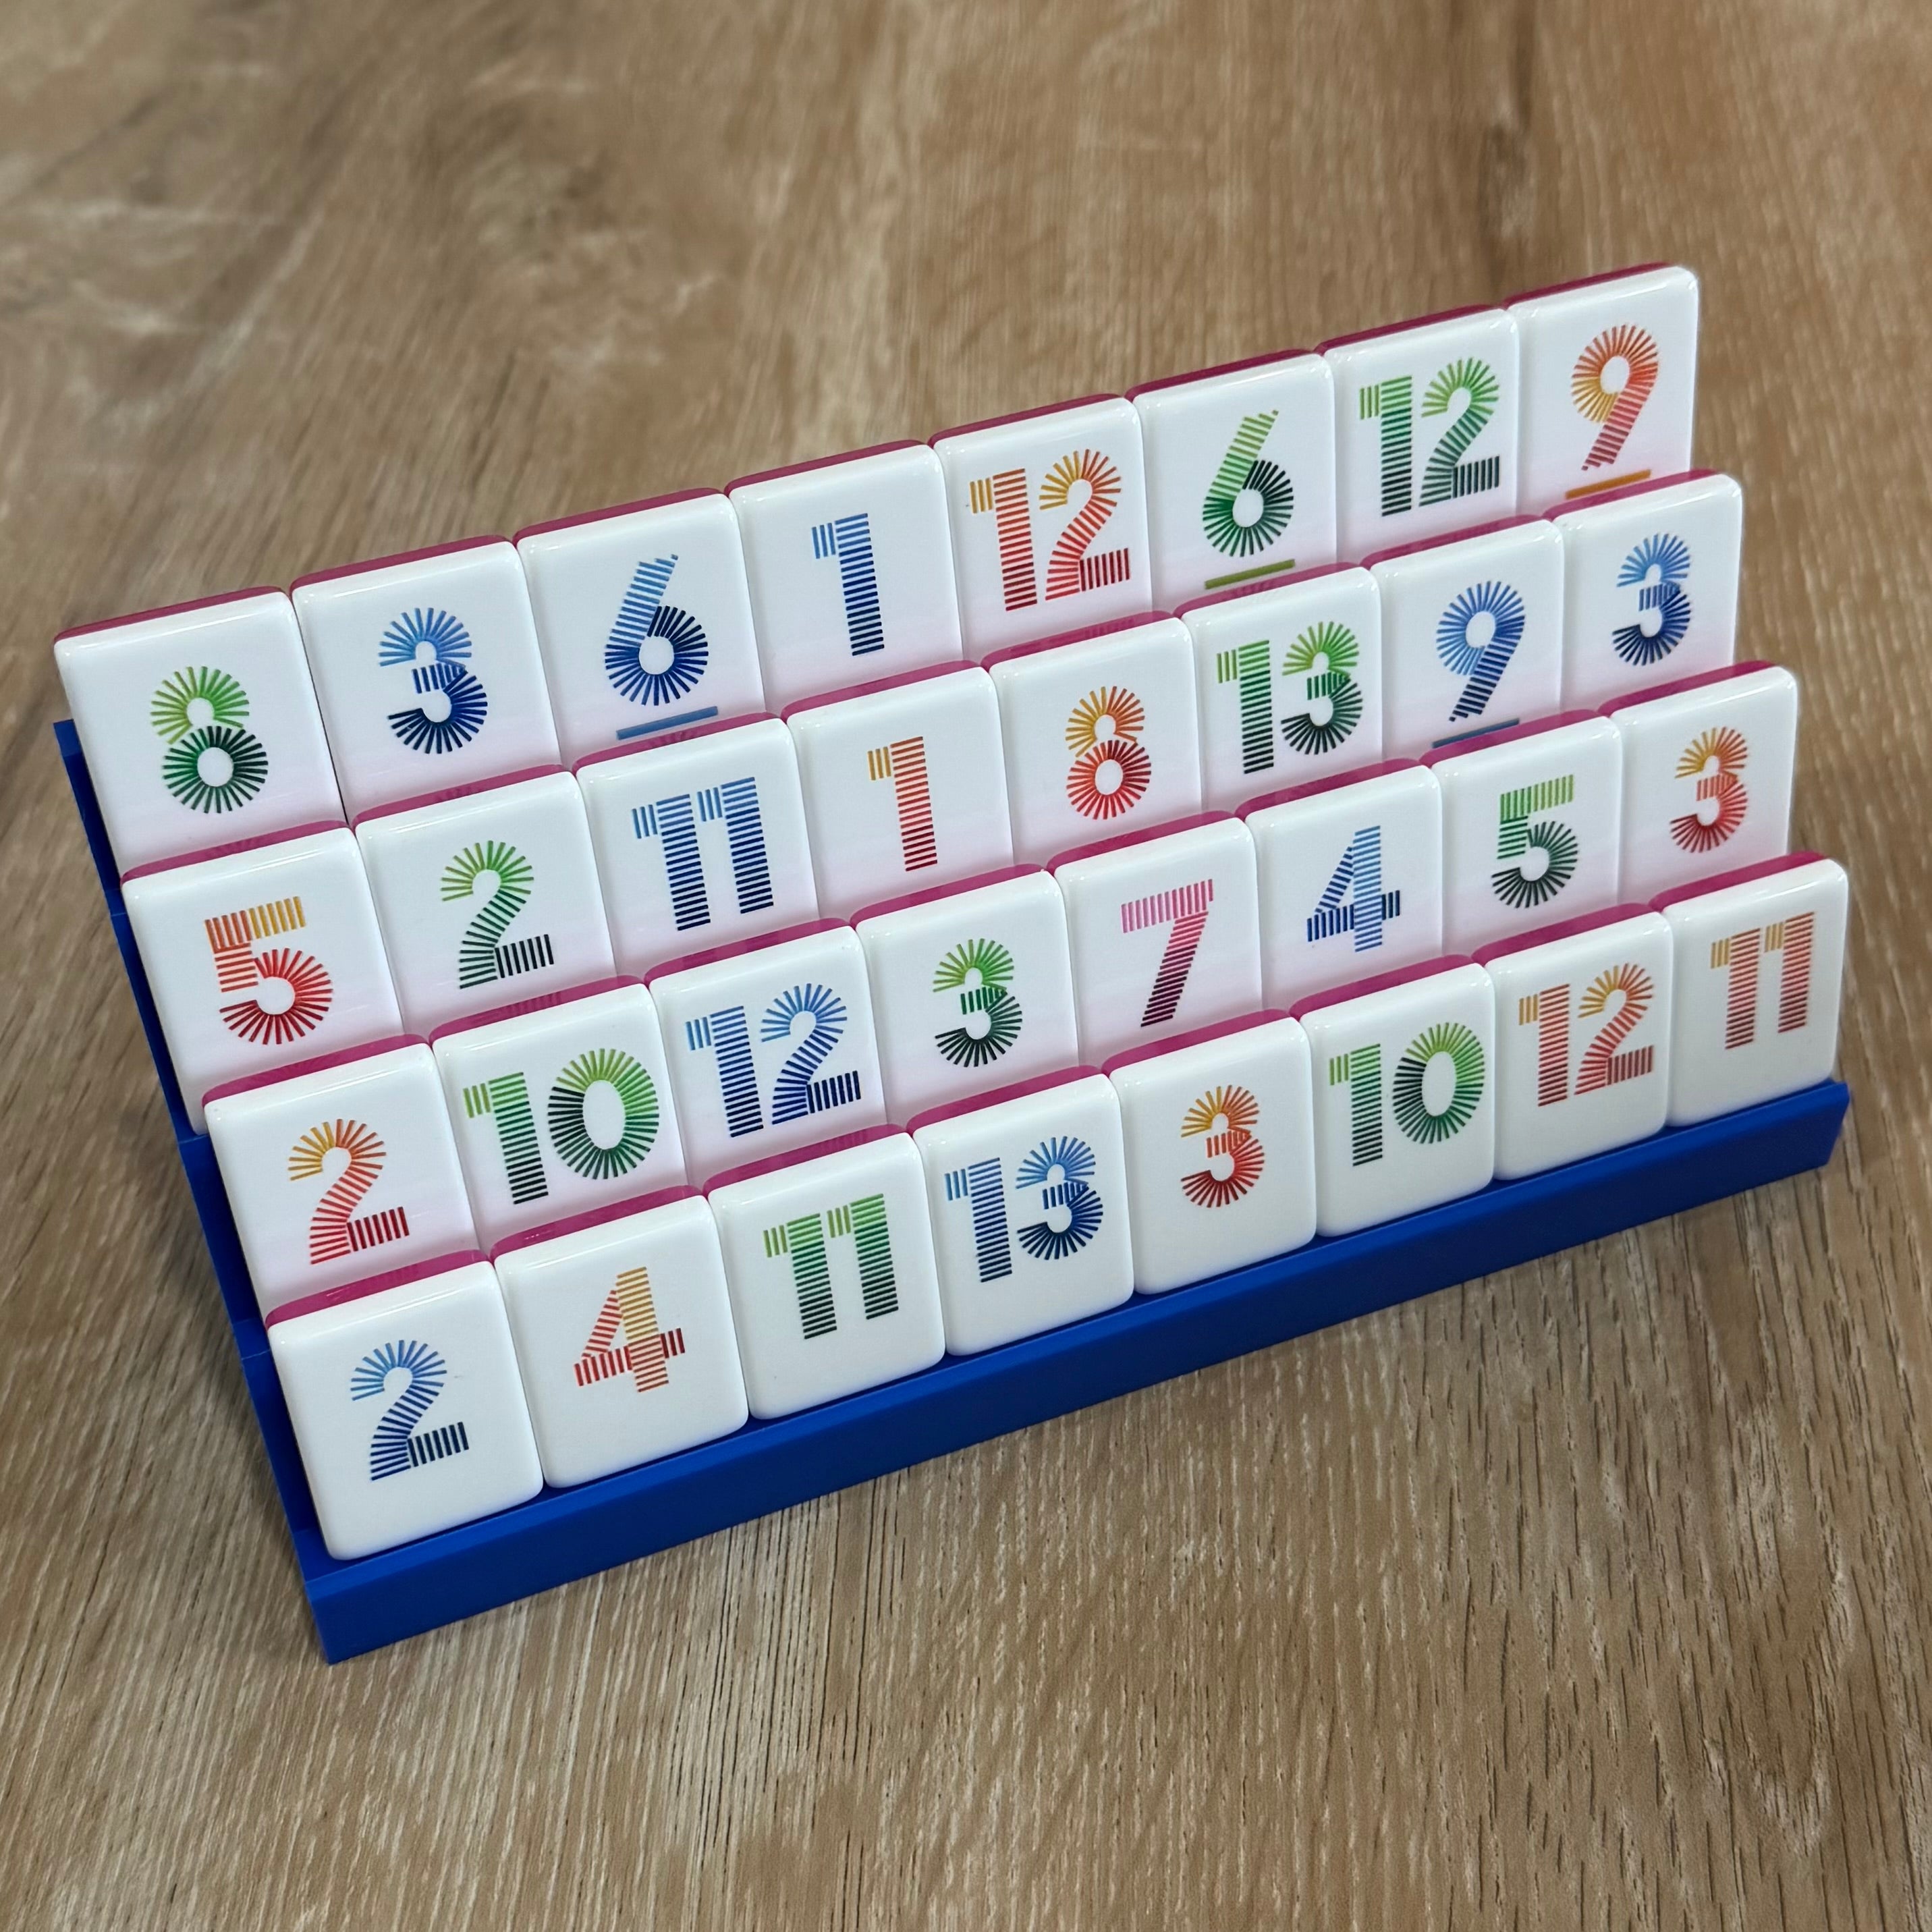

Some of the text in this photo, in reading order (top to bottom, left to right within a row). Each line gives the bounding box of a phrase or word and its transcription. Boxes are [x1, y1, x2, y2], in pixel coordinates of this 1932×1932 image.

[1360, 358, 1499, 517] 12
[1572, 325, 1659, 470] 9
[970, 449, 1130, 611] 12
[1203, 410, 1294, 557] 6
[605, 555, 709, 706] 6
[812, 513, 885, 656] 1
[1437, 581, 1525, 722] 9
[1612, 534, 1691, 666] 3
[150, 666, 269, 814] 8
[379, 608, 488, 754] 3
[1066, 686, 1151, 820] 8
[1217, 622, 1363, 774] 13
[632, 777, 773, 931] 11
[868, 736, 937, 872] 1
[1491, 775, 1578, 908] 5
[1670, 727, 1748, 853] 3
[441, 840, 554, 989] 2
[1122, 879, 1213, 1028] 7
[1307, 826, 1400, 952] 4
[204, 896, 333, 1045] 5
[933, 939, 1022, 1068] 3
[1519, 964, 1654, 1107] 12
[1711, 912, 1815, 1049] 11
[463, 1049, 659, 1205] 10
[686, 983, 861, 1138] 12
[1329, 1022, 1485, 1167] 10
[288, 1119, 410, 1265] 2
[945, 1136, 1103, 1283] 13
[1181, 1085, 1265, 1208] 3
[574, 1267, 685, 1392] 4
[763, 1194, 899, 1340] 11
[350, 1340, 469, 1481] 2
